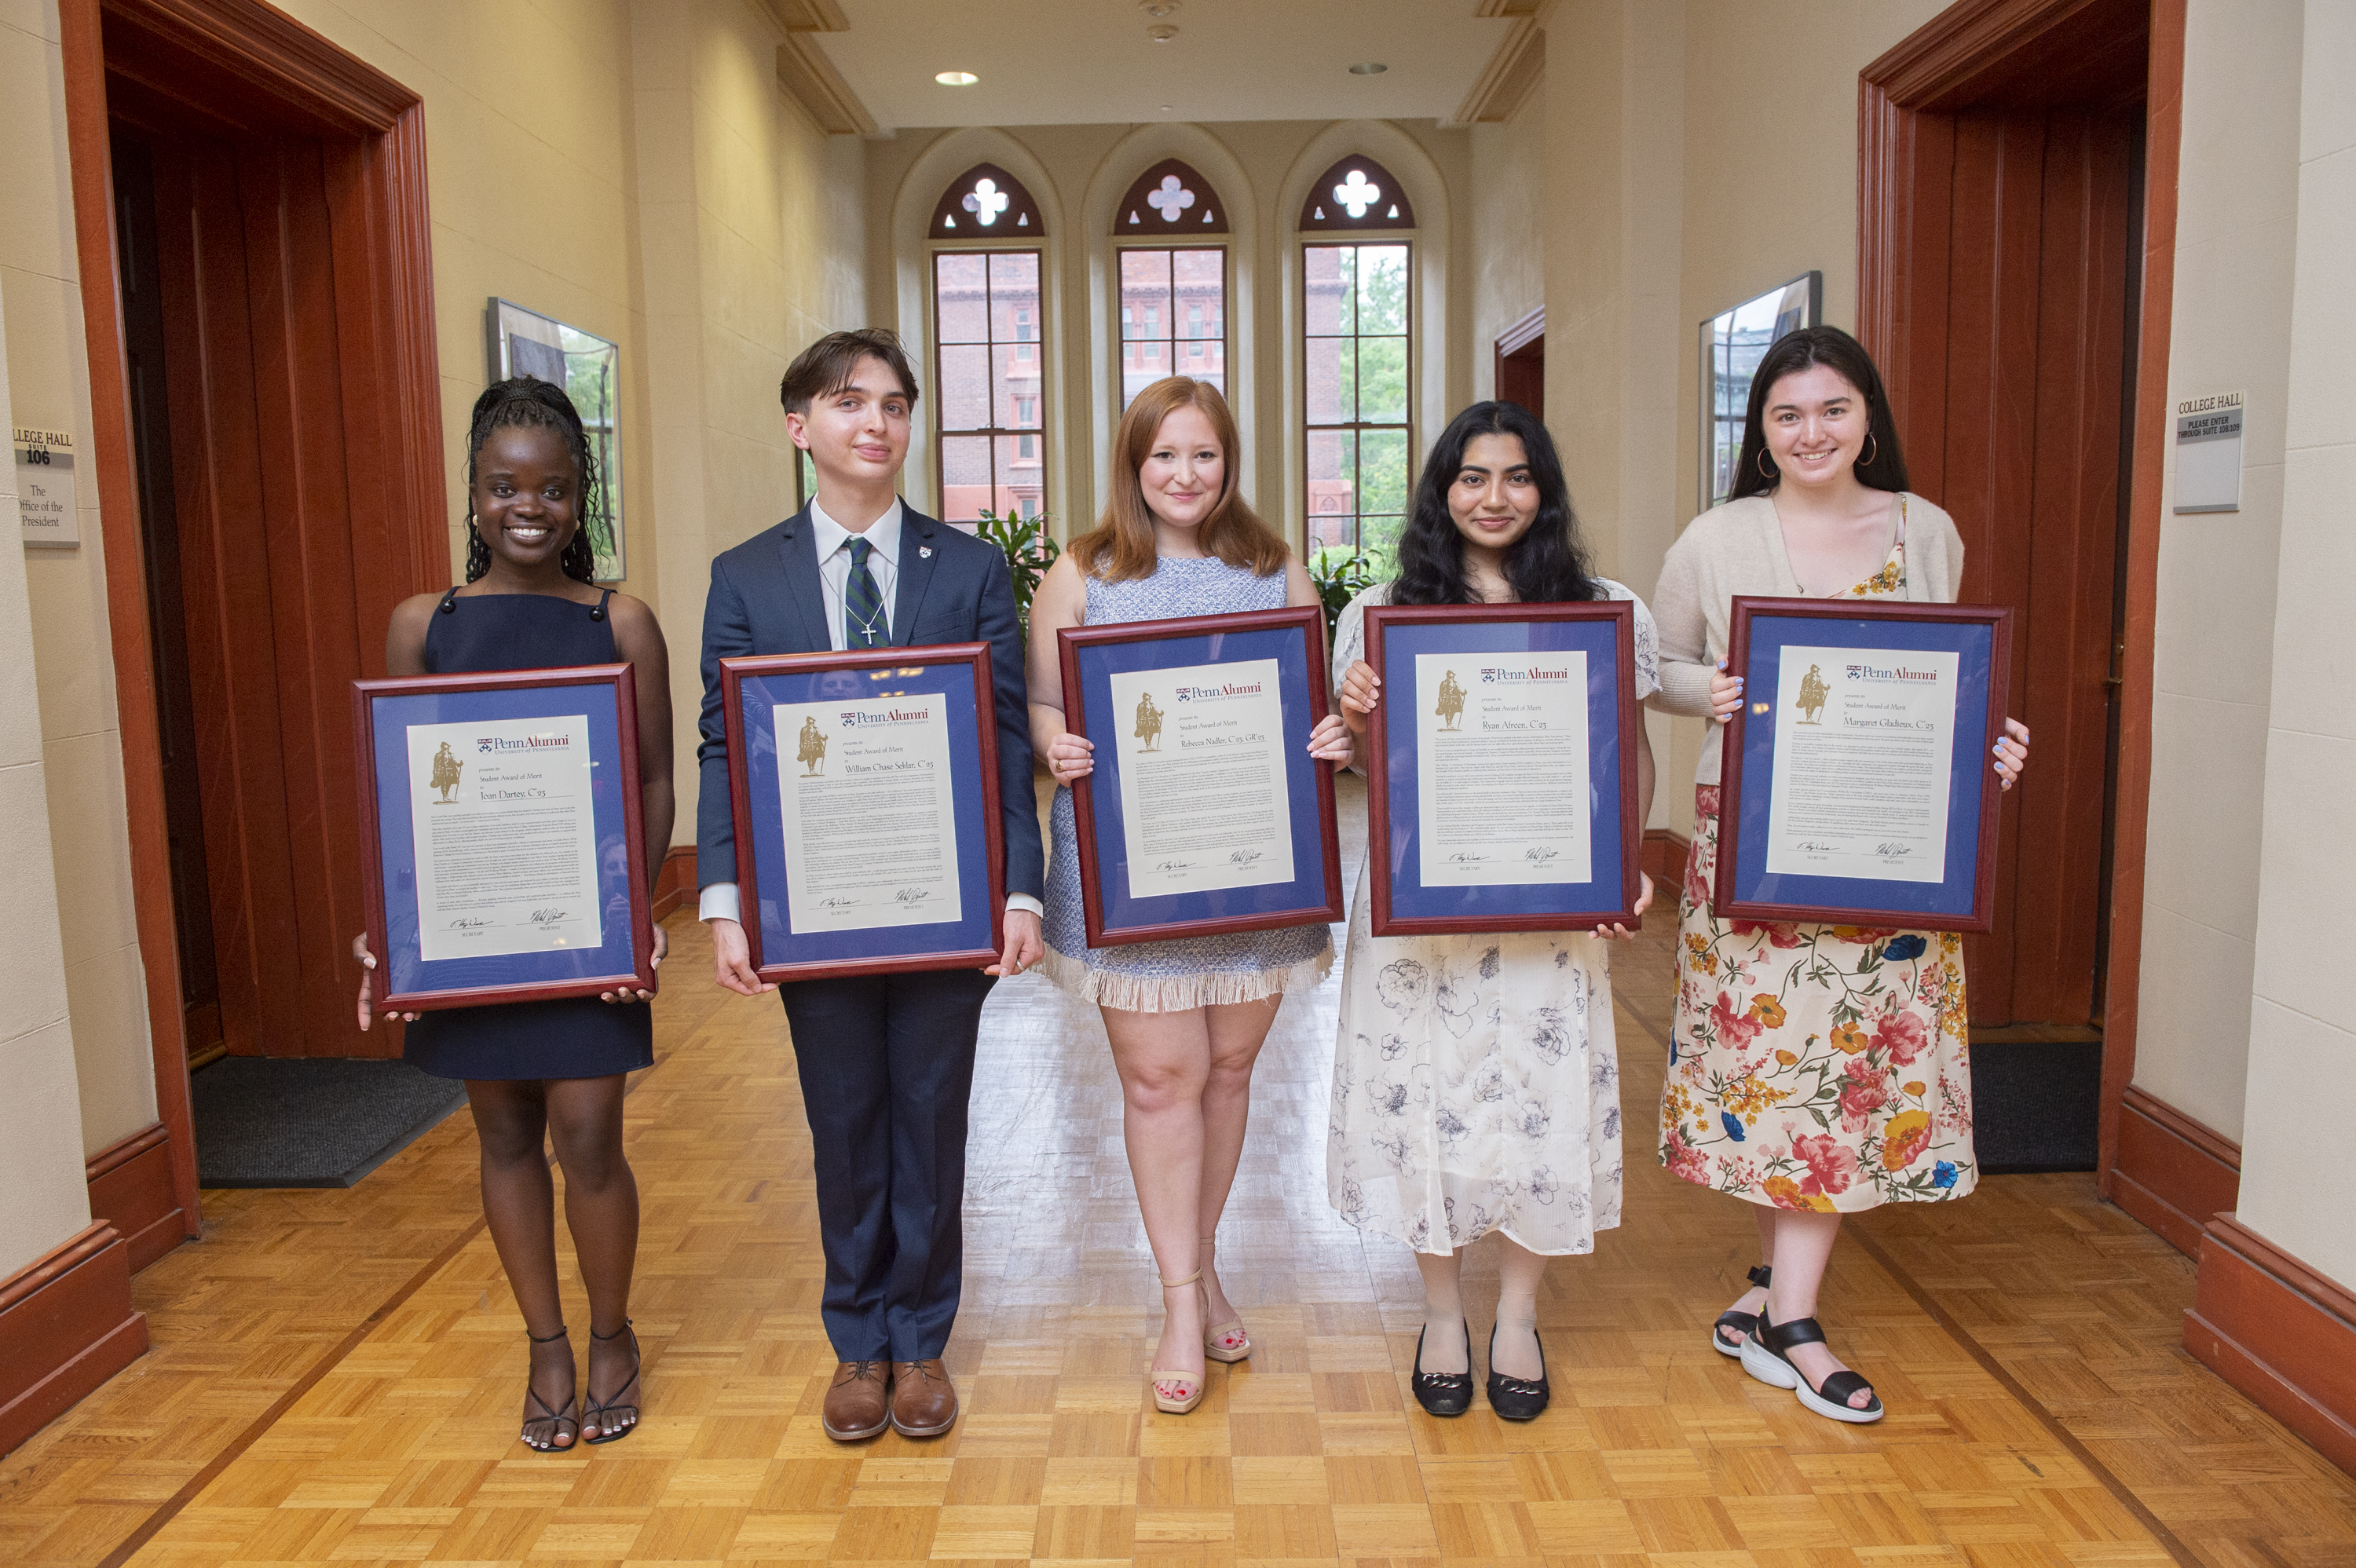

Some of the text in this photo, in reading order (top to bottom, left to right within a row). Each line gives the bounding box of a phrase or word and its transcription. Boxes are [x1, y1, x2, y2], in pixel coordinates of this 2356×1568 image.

[2179, 393, 2241, 414] COLLEGE HALL
[2188, 416, 2229, 429] PLEASE ENTER
[2178, 423, 2240, 439] THROUGH SUITE 108/109
[13, 429, 71, 446] LLEGE HALL
[27, 449, 50, 465] 106
[30, 485, 46, 496] The
[42, 501, 49, 511] of
[51, 501, 63, 512] the
[22, 515, 59, 527] President
[1483, 721, 1499, 731] Ryan
[1843, 717, 1878, 727] Margaret
[1181, 740, 1204, 748] Rebecca
[845, 764, 871, 773] William
[481, 791, 496, 800] Joan
